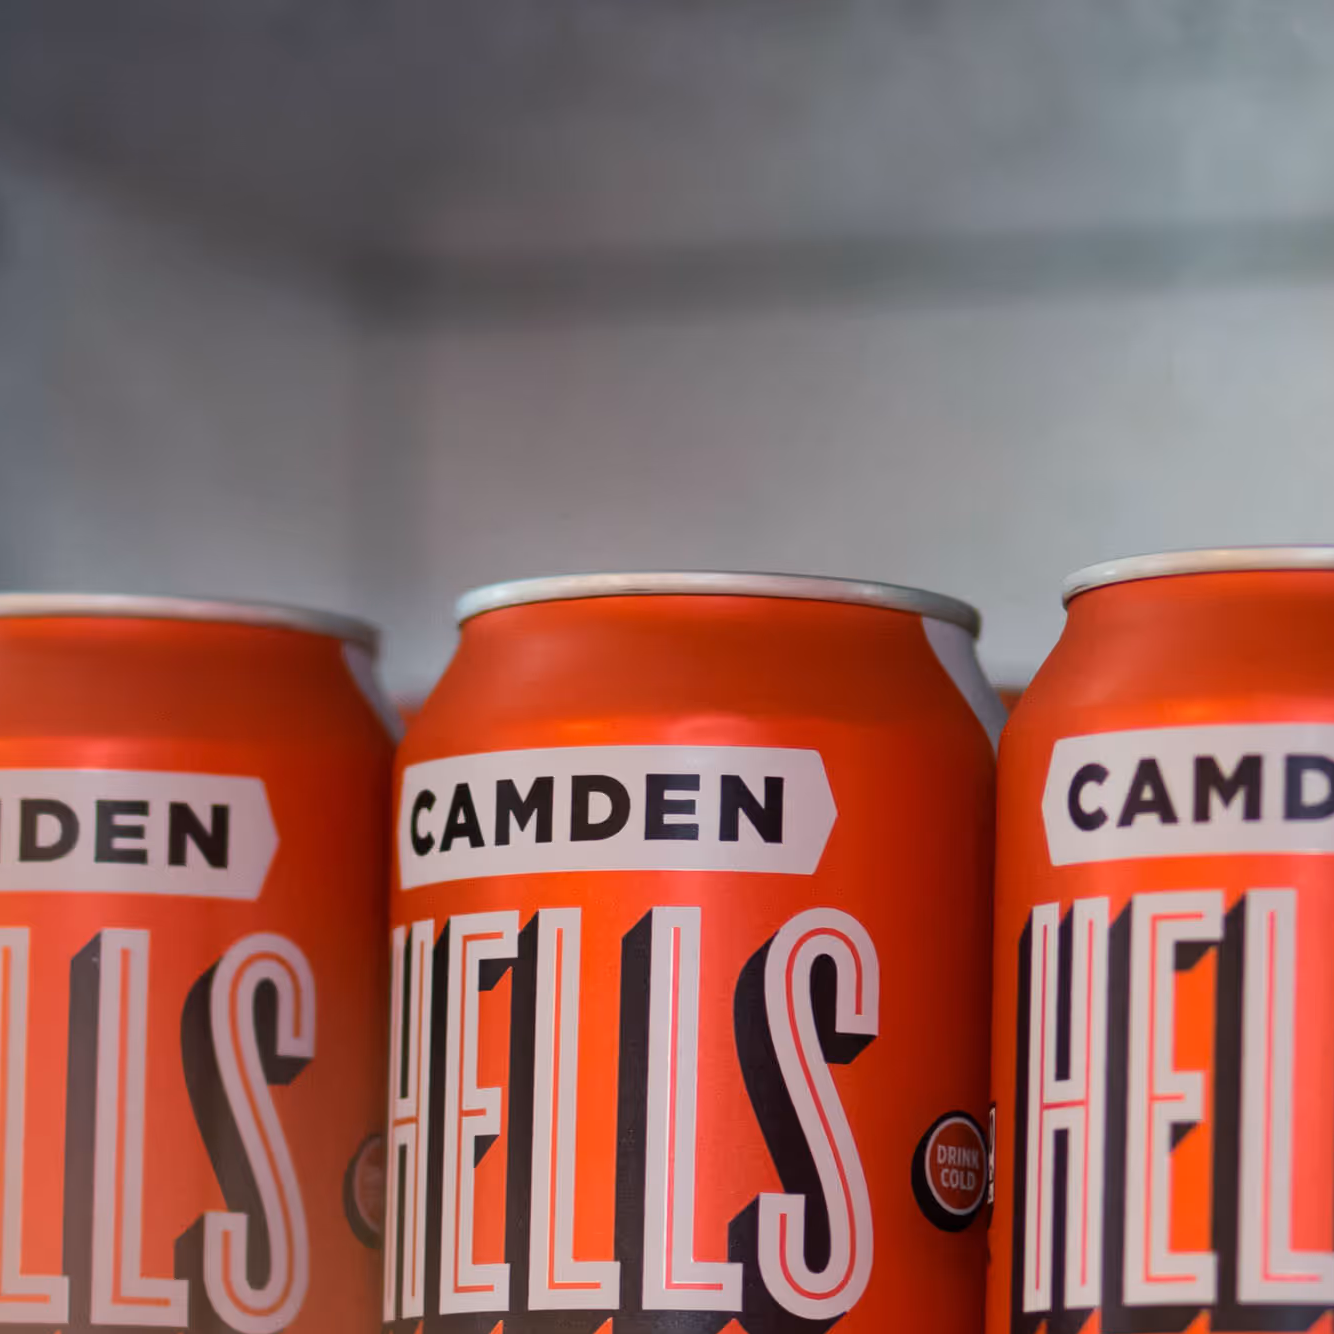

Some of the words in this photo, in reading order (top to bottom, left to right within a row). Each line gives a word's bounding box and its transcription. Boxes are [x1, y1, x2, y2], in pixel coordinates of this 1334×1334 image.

[409, 772, 785, 857] CAMDEN
[936, 1144, 979, 1170] DRINK
[940, 1168, 976, 1191] COLD
